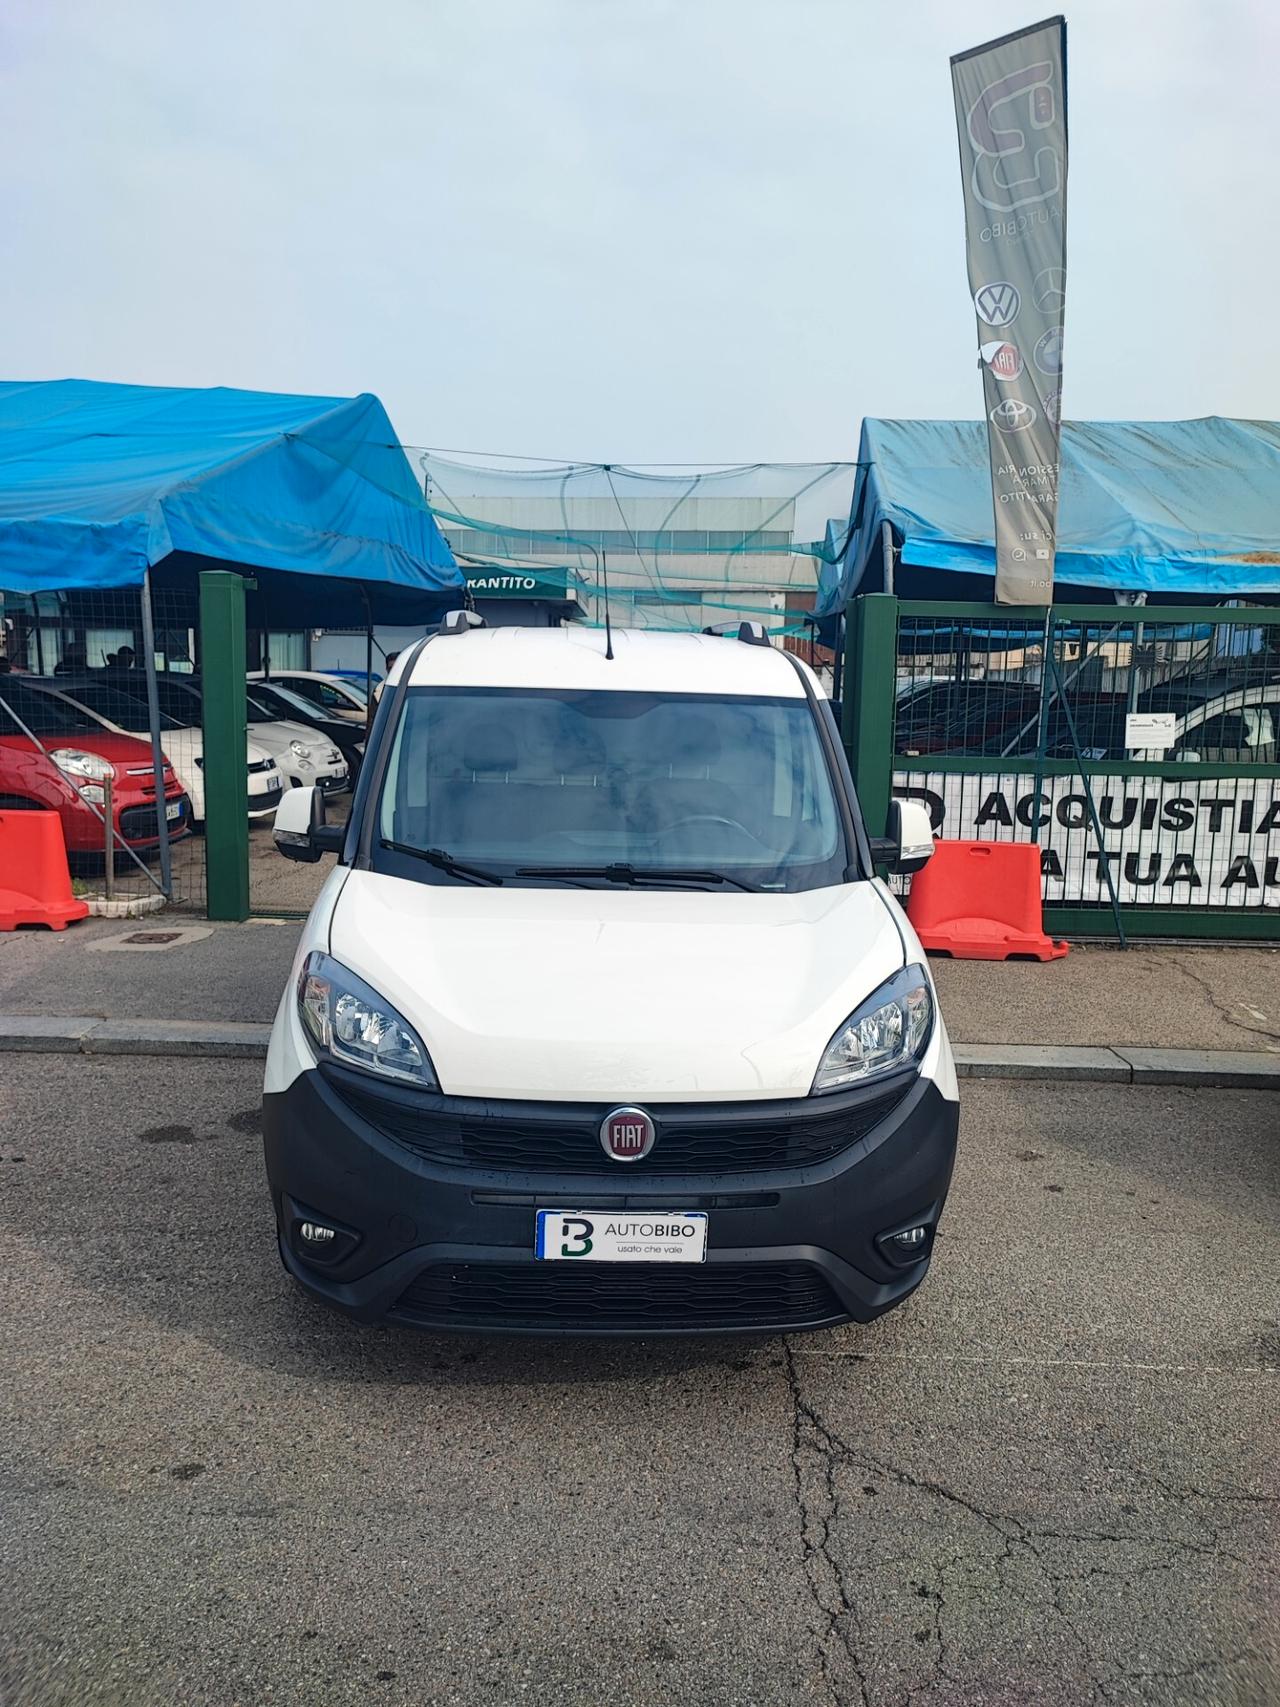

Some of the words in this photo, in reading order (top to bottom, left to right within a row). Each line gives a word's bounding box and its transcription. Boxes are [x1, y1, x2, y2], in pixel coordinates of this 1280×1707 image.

[1086, 850, 1202, 888] TUA
[613, 1124, 644, 1148] FIAT
[604, 1223, 696, 1238] AUTOBIBO
[617, 1244, 642, 1254] usato
[643, 1244, 662, 1254] che
[663, 1245, 683, 1255] vale
